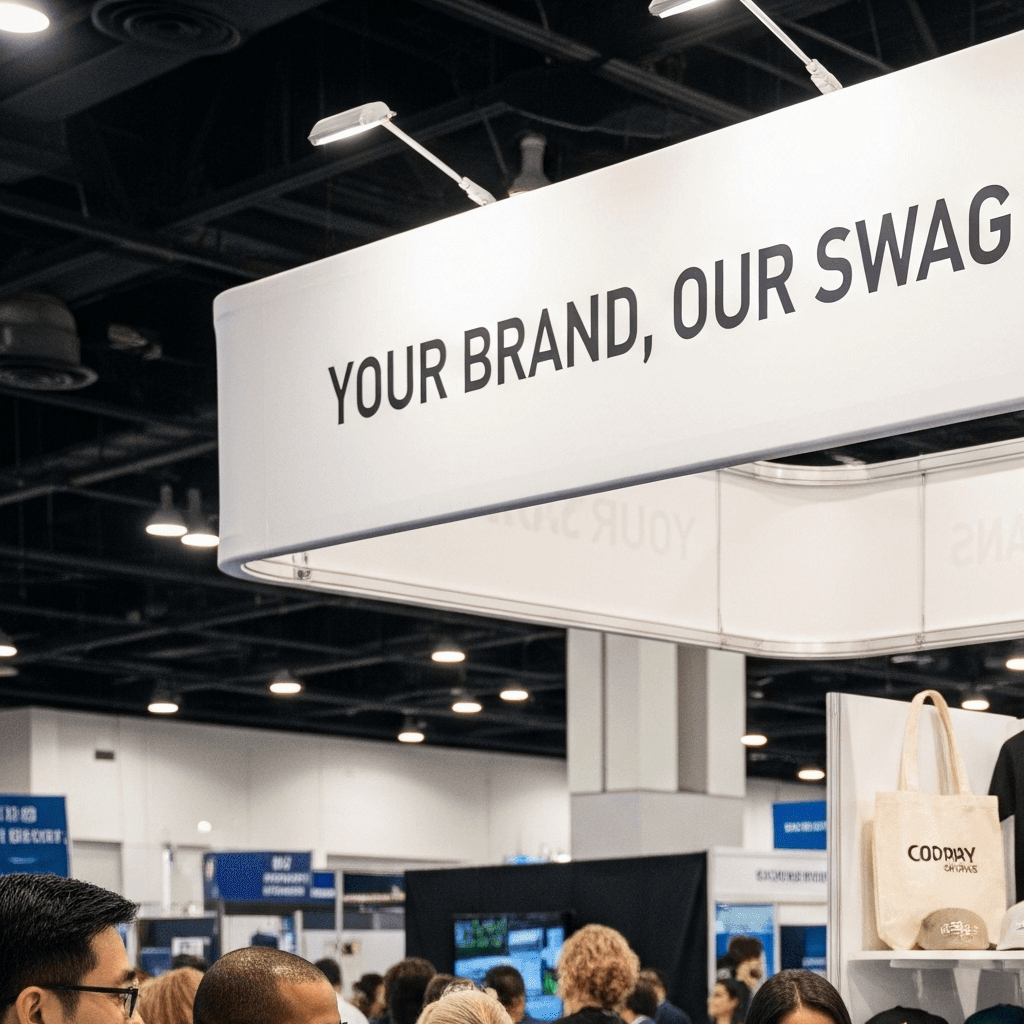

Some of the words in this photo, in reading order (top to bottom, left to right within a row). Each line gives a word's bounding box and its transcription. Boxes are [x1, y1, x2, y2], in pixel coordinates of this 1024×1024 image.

[328, 338, 448, 425] YOUR
[463, 286, 654, 394] BRAND,
[672, 243, 796, 341] OUR
[814, 184, 1012, 304] SWAG
